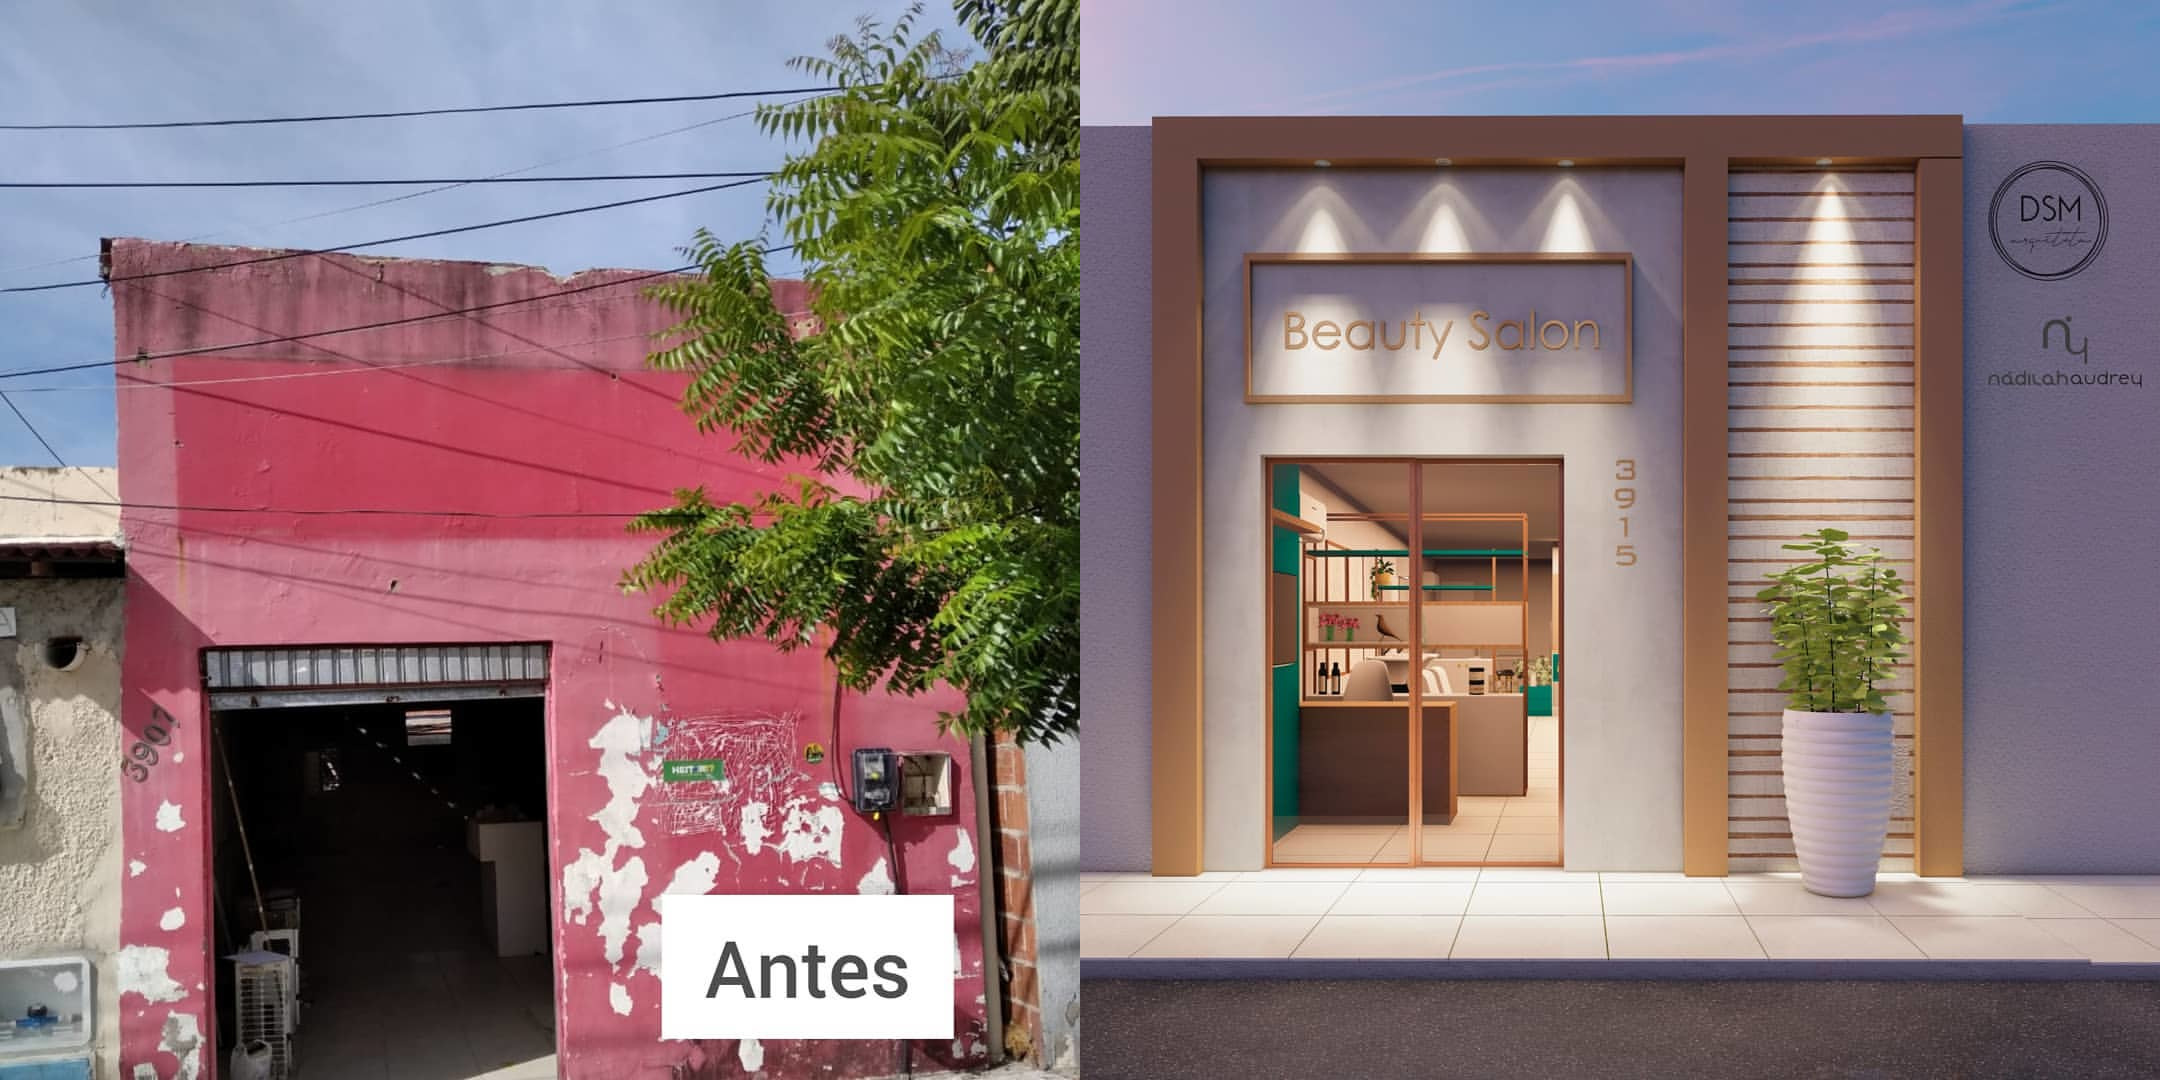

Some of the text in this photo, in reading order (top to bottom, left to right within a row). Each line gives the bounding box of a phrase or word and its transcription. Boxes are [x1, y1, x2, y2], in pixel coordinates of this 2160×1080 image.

[1283, 310, 1601, 361] Beauty Salon
[1614, 458, 1638, 568] 3915
